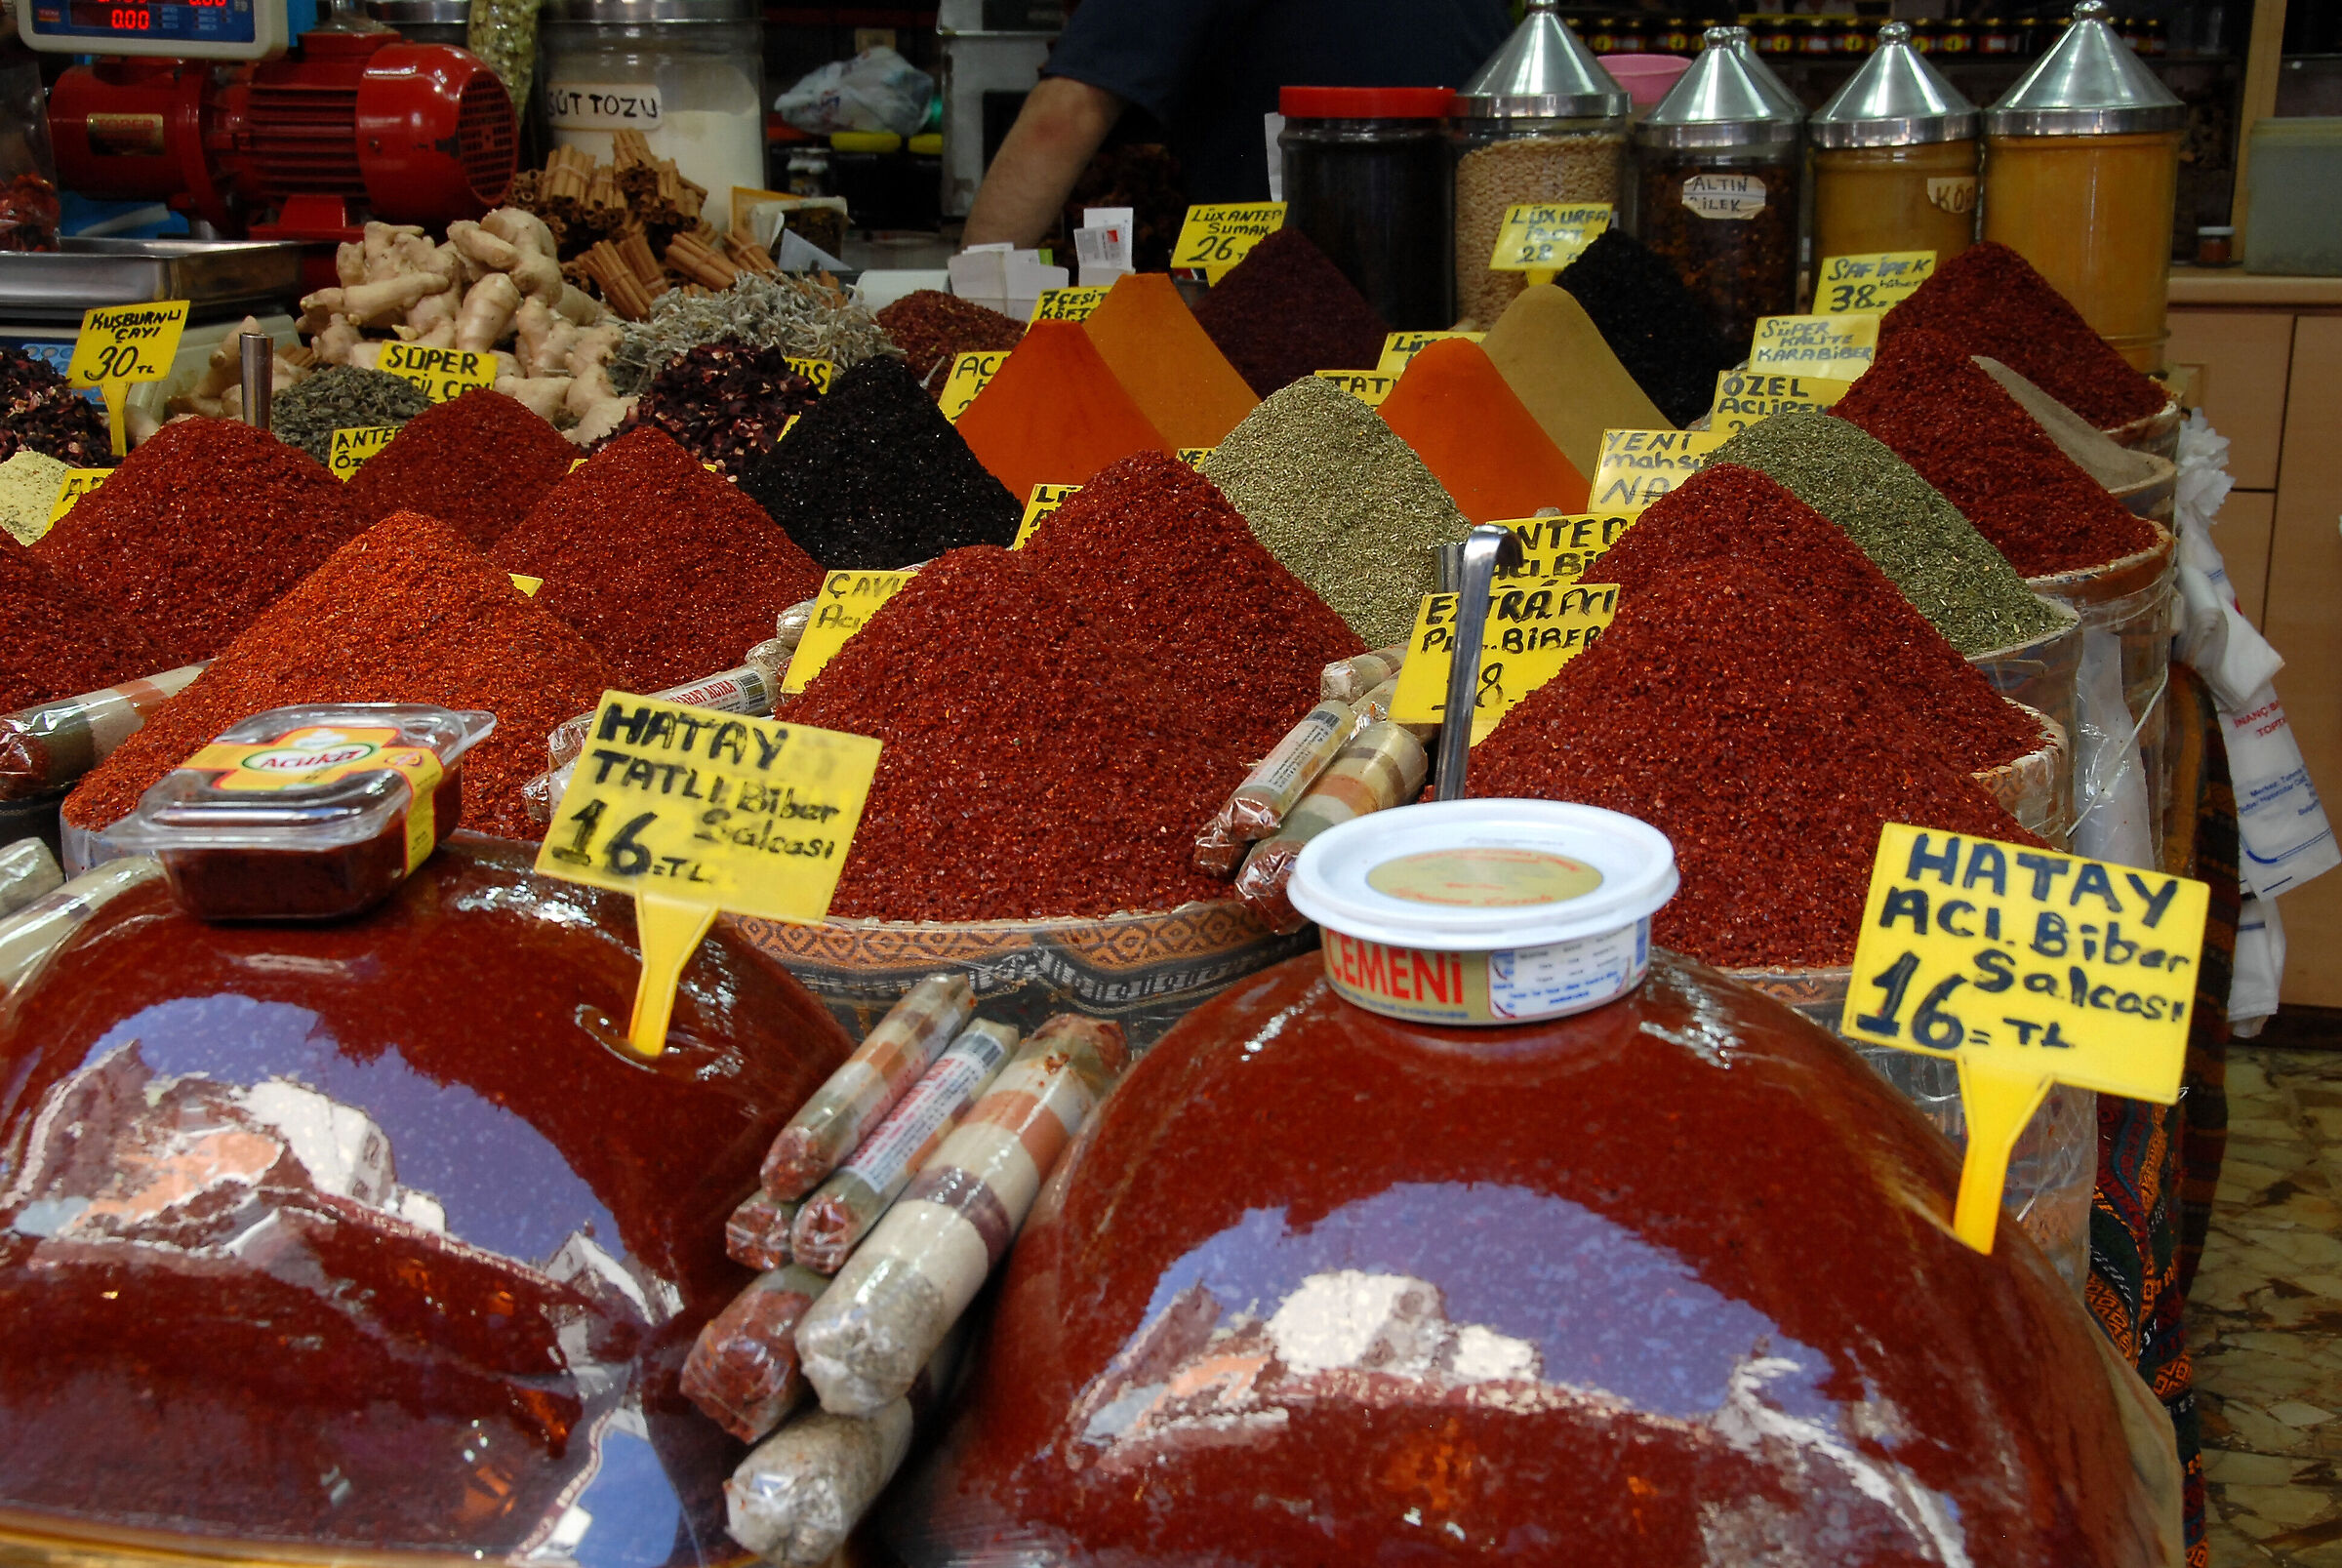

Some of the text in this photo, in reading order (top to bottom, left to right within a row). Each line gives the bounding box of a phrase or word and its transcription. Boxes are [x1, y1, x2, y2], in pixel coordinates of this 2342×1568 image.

[588, 94, 658, 118] TOZU
[1187, 235, 1236, 261] 26
[84, 345, 139, 382] 30
[385, 344, 479, 377] SÜPER
[1722, 372, 1809, 398] ÖZEL
[596, 704, 788, 771] HATAY
[1905, 832, 2179, 929] HATAY
